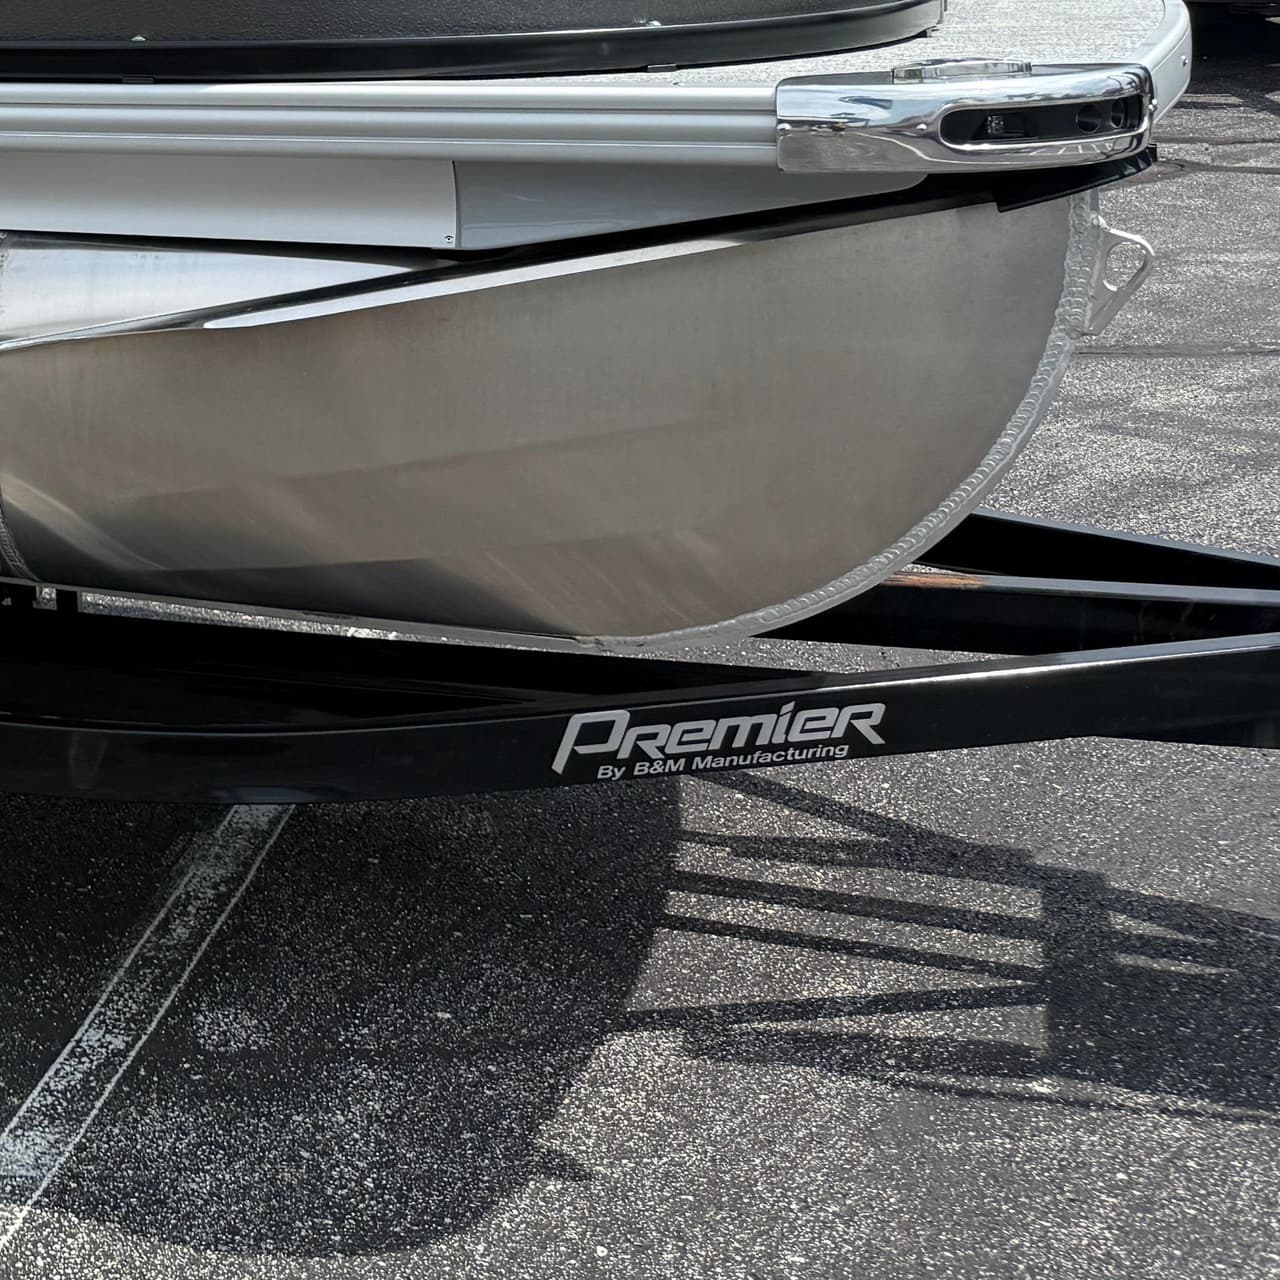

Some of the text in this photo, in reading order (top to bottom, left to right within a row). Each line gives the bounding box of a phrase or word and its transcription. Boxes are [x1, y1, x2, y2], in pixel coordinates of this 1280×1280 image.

[597, 744, 850, 781] By B&M Manufacturing
